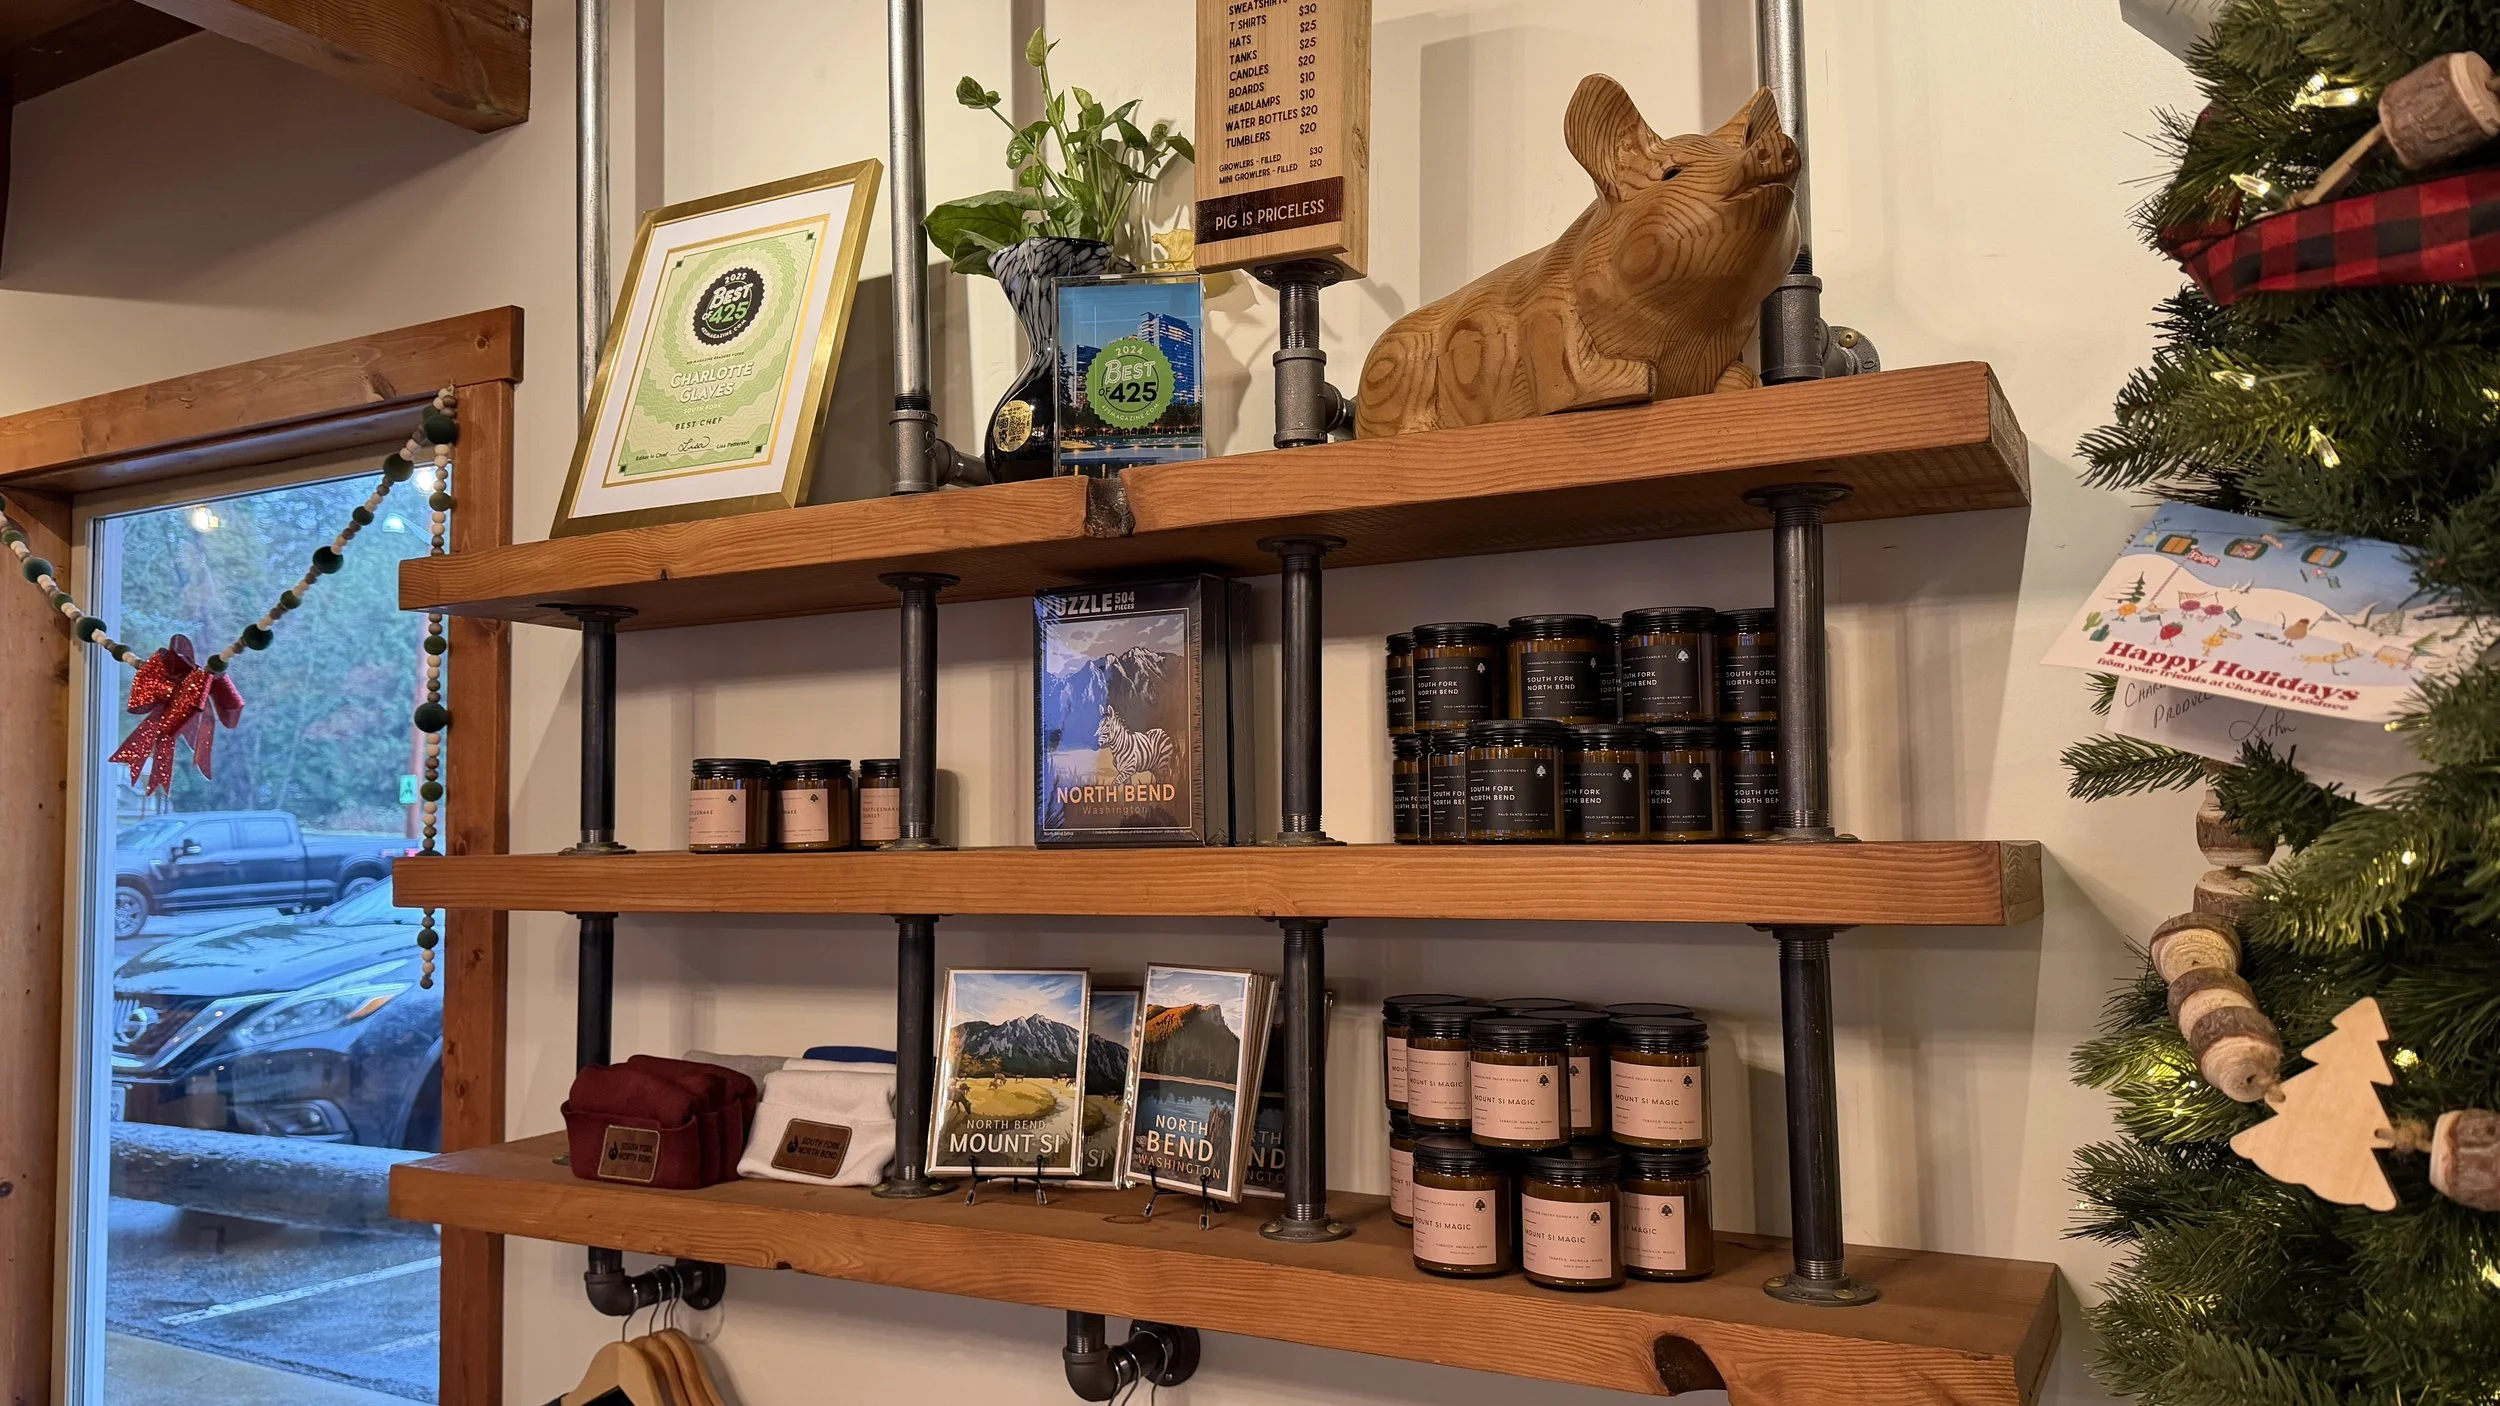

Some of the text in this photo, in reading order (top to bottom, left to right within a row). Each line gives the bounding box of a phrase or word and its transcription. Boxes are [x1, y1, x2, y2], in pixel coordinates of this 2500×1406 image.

[1229, 0, 1288, 15] SWEATSHIR
[1230, 3, 1317, 32] T SHIRTS $30
[1229, 20, 1316, 48] HATS $25
[1229, 37, 1316, 64] TANKS $25
[1229, 54, 1315, 81] CANDLES $20
[1229, 71, 1315, 98] BOARDS $10
[1228, 88, 1315, 115] HEADLAMPS $10
[1226, 105, 1317, 132] WATER BOTTLES $20
[1226, 122, 1316, 148] TUMBLERS $20
[1219, 159, 1253, 171] GROWLERS
[1261, 154, 1281, 164] FILLED
[1310, 146, 1323, 155] $30
[1219, 175, 1232, 184] MINI
[1235, 168, 1270, 181] GROWLERS
[1277, 163, 1298, 173] FILLED
[1310, 159, 1322, 168] $20
[1216, 199, 1325, 231] PIG IS PRICELESS
[725, 273, 747, 283] 2025
[709, 283, 753, 310] BEST
[702, 301, 749, 323] OF 425
[1116, 346, 1143, 356] 2024
[670, 362, 754, 388] CHARLOTTE
[1105, 360, 1156, 385] BEST
[680, 383, 735, 403] GLAVES
[1099, 382, 1157, 402] OF 425
[675, 417, 723, 430] BEST CHEF
[1115, 592, 1134, 604] 504
[2105, 642, 2360, 702] Happy Holidays
[2097, 657, 2349, 711] from your friends at Charlie's Produce
[1057, 784, 1175, 803] NORTH BEND
[1083, 806, 1147, 815] Washington
[1475, 1095, 1495, 1103] MOUNT
[1616, 1094, 1638, 1102] MOUNT
[967, 1119, 1046, 1129] NORTH BEND
[1156, 1115, 1208, 1135] NORTH
[621, 1142, 652, 1152] SOUTH FORK
[802, 1137, 840, 1149] SOUTH FORK
[950, 1133, 1060, 1153] MOUNT SI
[1147, 1130, 1214, 1162] BEND
[1250, 1130, 1281, 1145] RTH
[620, 1152, 653, 1163] NORTH BEND
[799, 1147, 837, 1160] NORTH BEND
[1087, 1149, 1105, 1168] SI
[1247, 1147, 1285, 1169] ND
[1138, 1154, 1221, 1179] WASHINGTON
[1415, 1216, 1432, 1226] MOUNT
[1632, 1226, 1657, 1234] MAGIC
[1525, 1229, 1544, 1239] MOUNT
